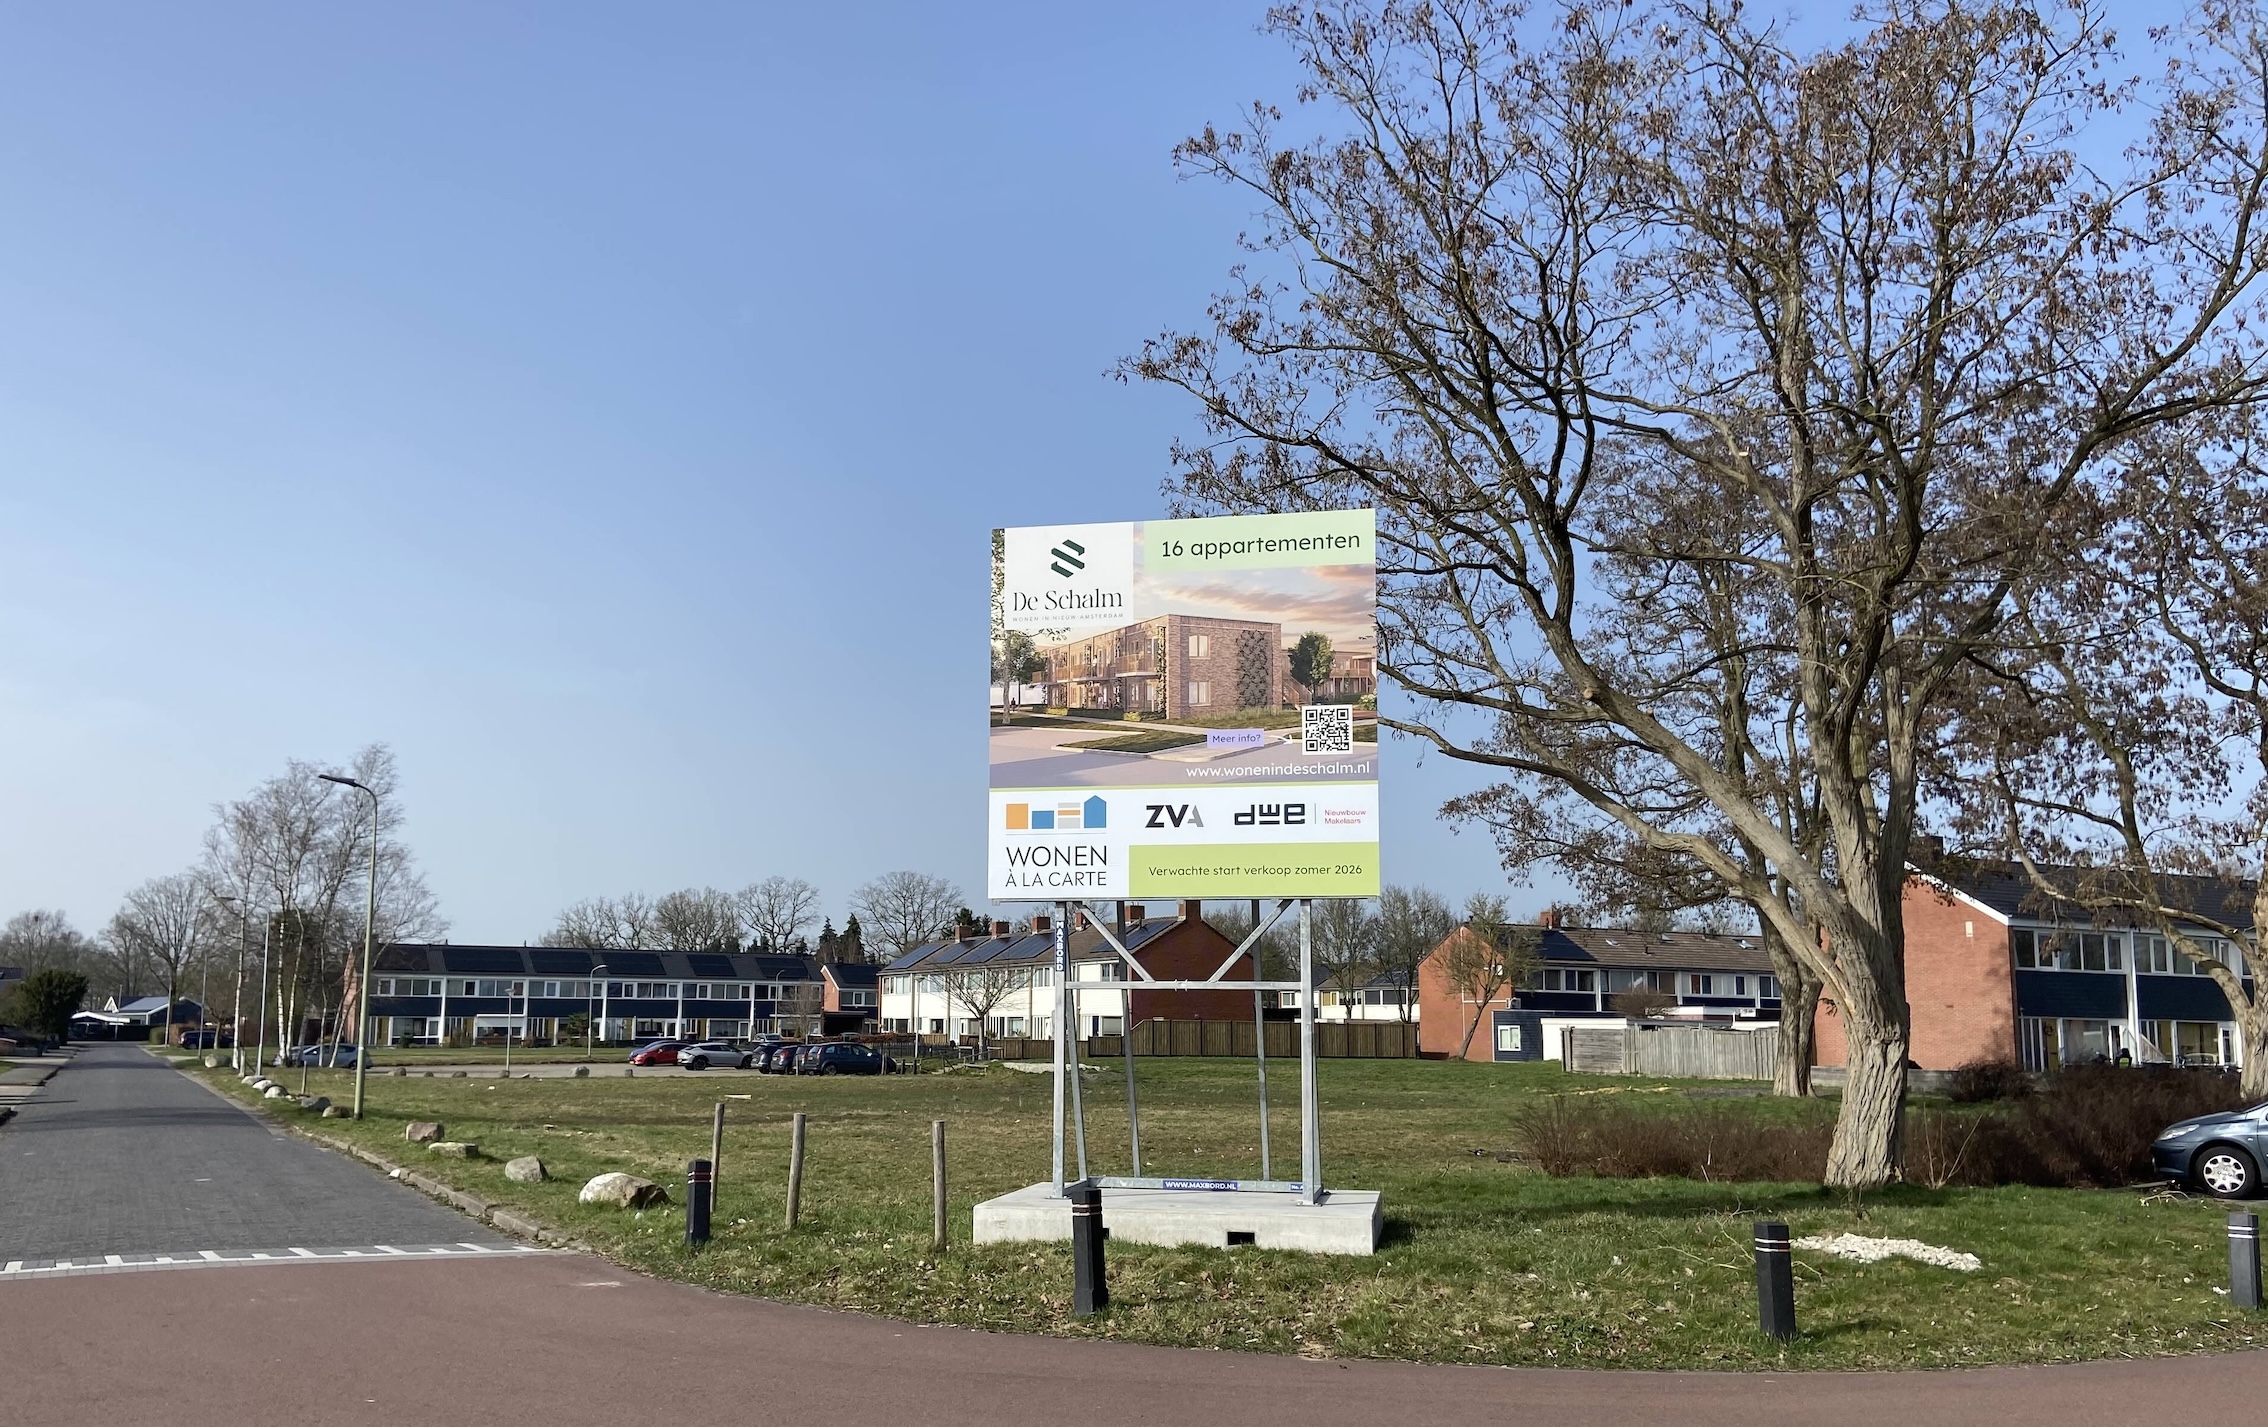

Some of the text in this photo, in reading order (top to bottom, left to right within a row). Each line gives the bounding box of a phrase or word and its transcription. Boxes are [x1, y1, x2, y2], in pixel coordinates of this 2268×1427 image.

[1162, 533, 1360, 560] 16 appartementen
[1013, 588, 1124, 612] De Schalm
[1212, 734, 1261, 743] Meer info?
[1186, 761, 1370, 778] www.wonenindeschalm.nl
[1145, 804, 1204, 828] ZVA
[1006, 845, 1107, 867] WONEN
[1005, 868, 1107, 887] À LA CARTE
[1148, 864, 1363, 877] Verwachte start verkoop zomer 2026
[1056, 921, 1064, 971] MAXBORD
[1165, 1181, 1237, 1190] WWW.MAXBORD.NL
